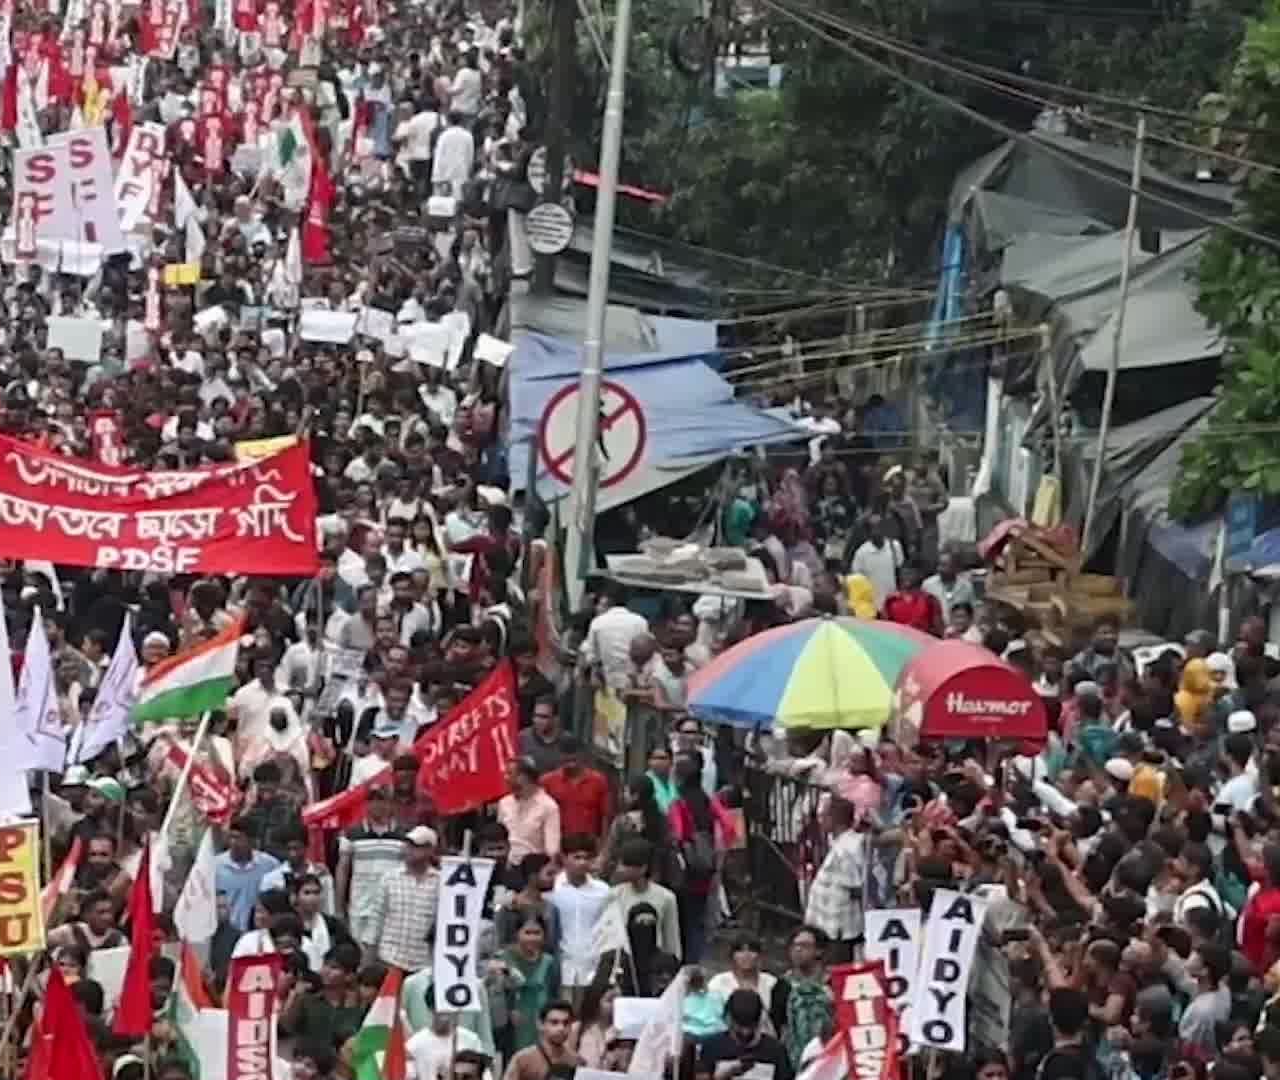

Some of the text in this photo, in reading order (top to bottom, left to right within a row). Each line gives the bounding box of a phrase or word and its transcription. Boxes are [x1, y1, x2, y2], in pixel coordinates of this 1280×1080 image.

[96, 545, 202, 573] PDSF
[946, 692, 1032, 716] Havmor
[443, 862, 478, 1009] AIDYO
[922, 896, 975, 1045] AIDYO
